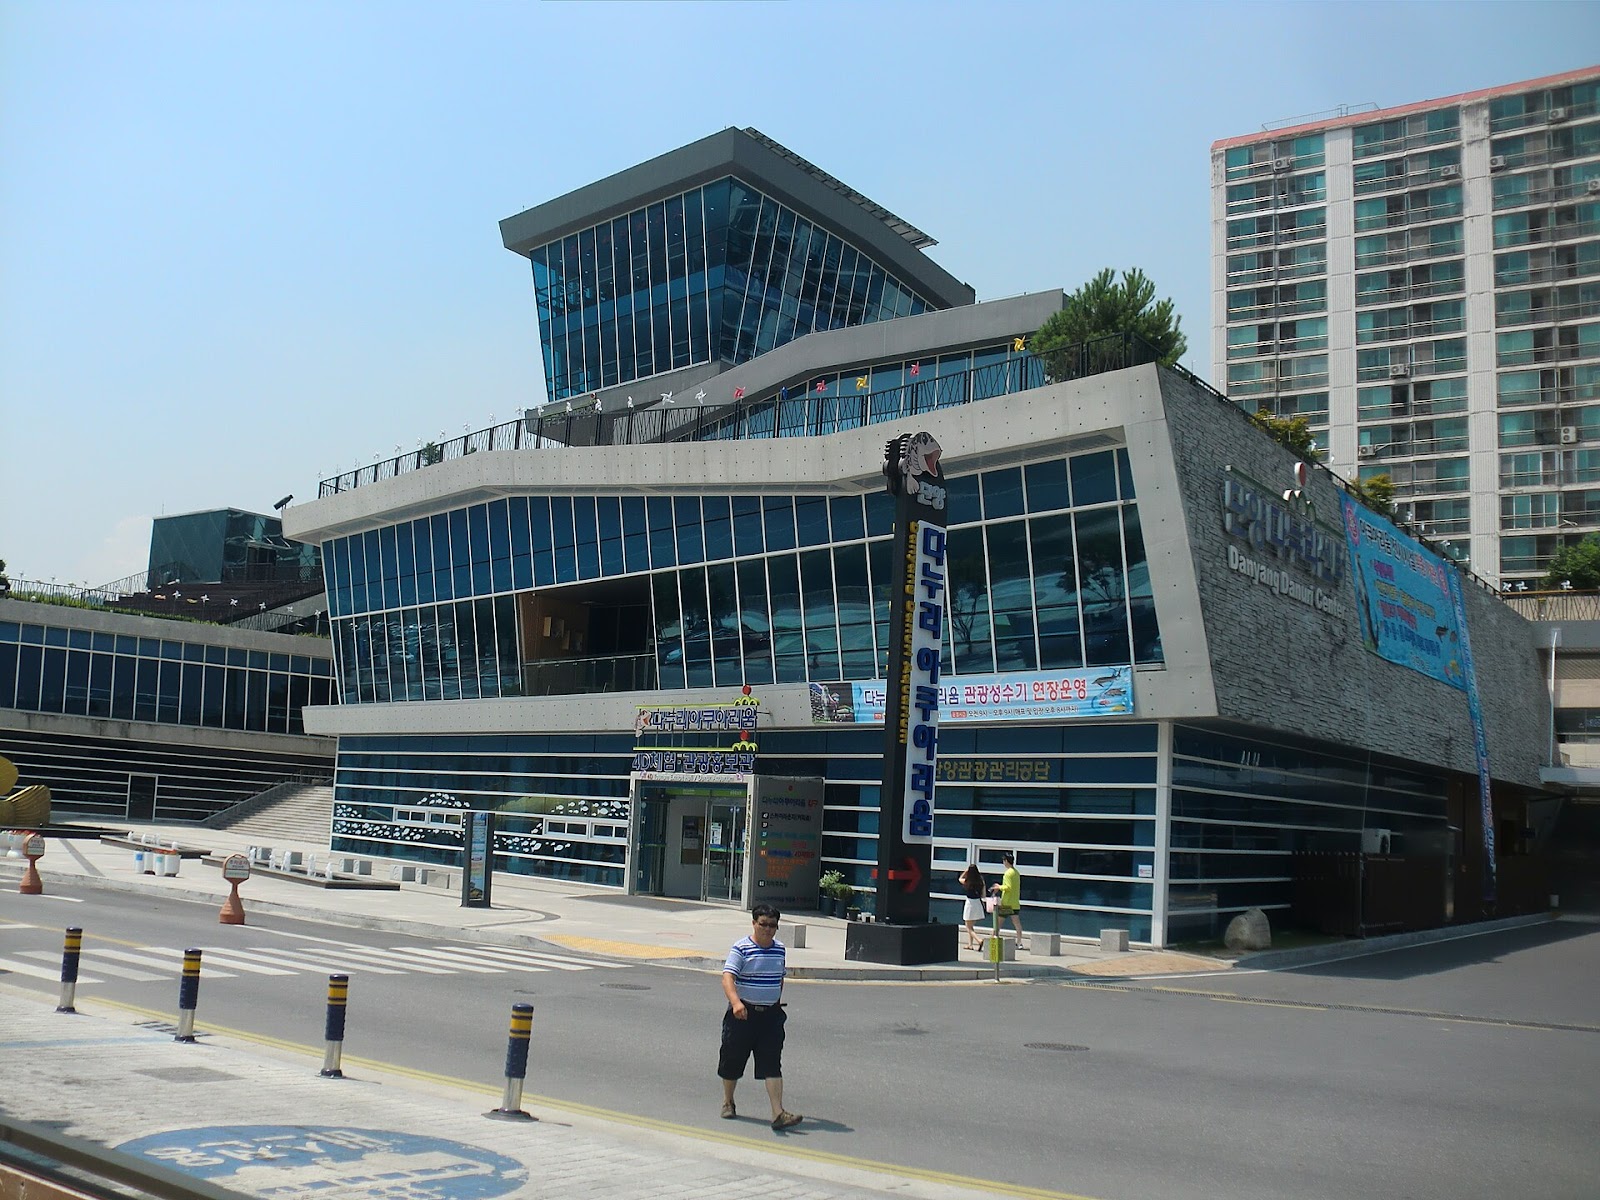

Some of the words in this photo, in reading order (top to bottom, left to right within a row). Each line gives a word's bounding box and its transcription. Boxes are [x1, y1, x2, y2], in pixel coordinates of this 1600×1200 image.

[917, 481, 946, 510] 단양
[905, 520, 919, 595] Danyang
[1228, 545, 1281, 595] Danyang
[1280, 571, 1314, 606] Danuri
[1315, 589, 1346, 618] Center
[903, 600, 916, 657] Danuri
[899, 661, 913, 744] Aquarium
[908, 526, 947, 836] 다누리아쿠아리움
[964, 682, 1028, 704] 관광성수기
[1032, 678, 1087, 702] 연장운영
[650, 707, 757, 731] 다누리아쿠아리움
